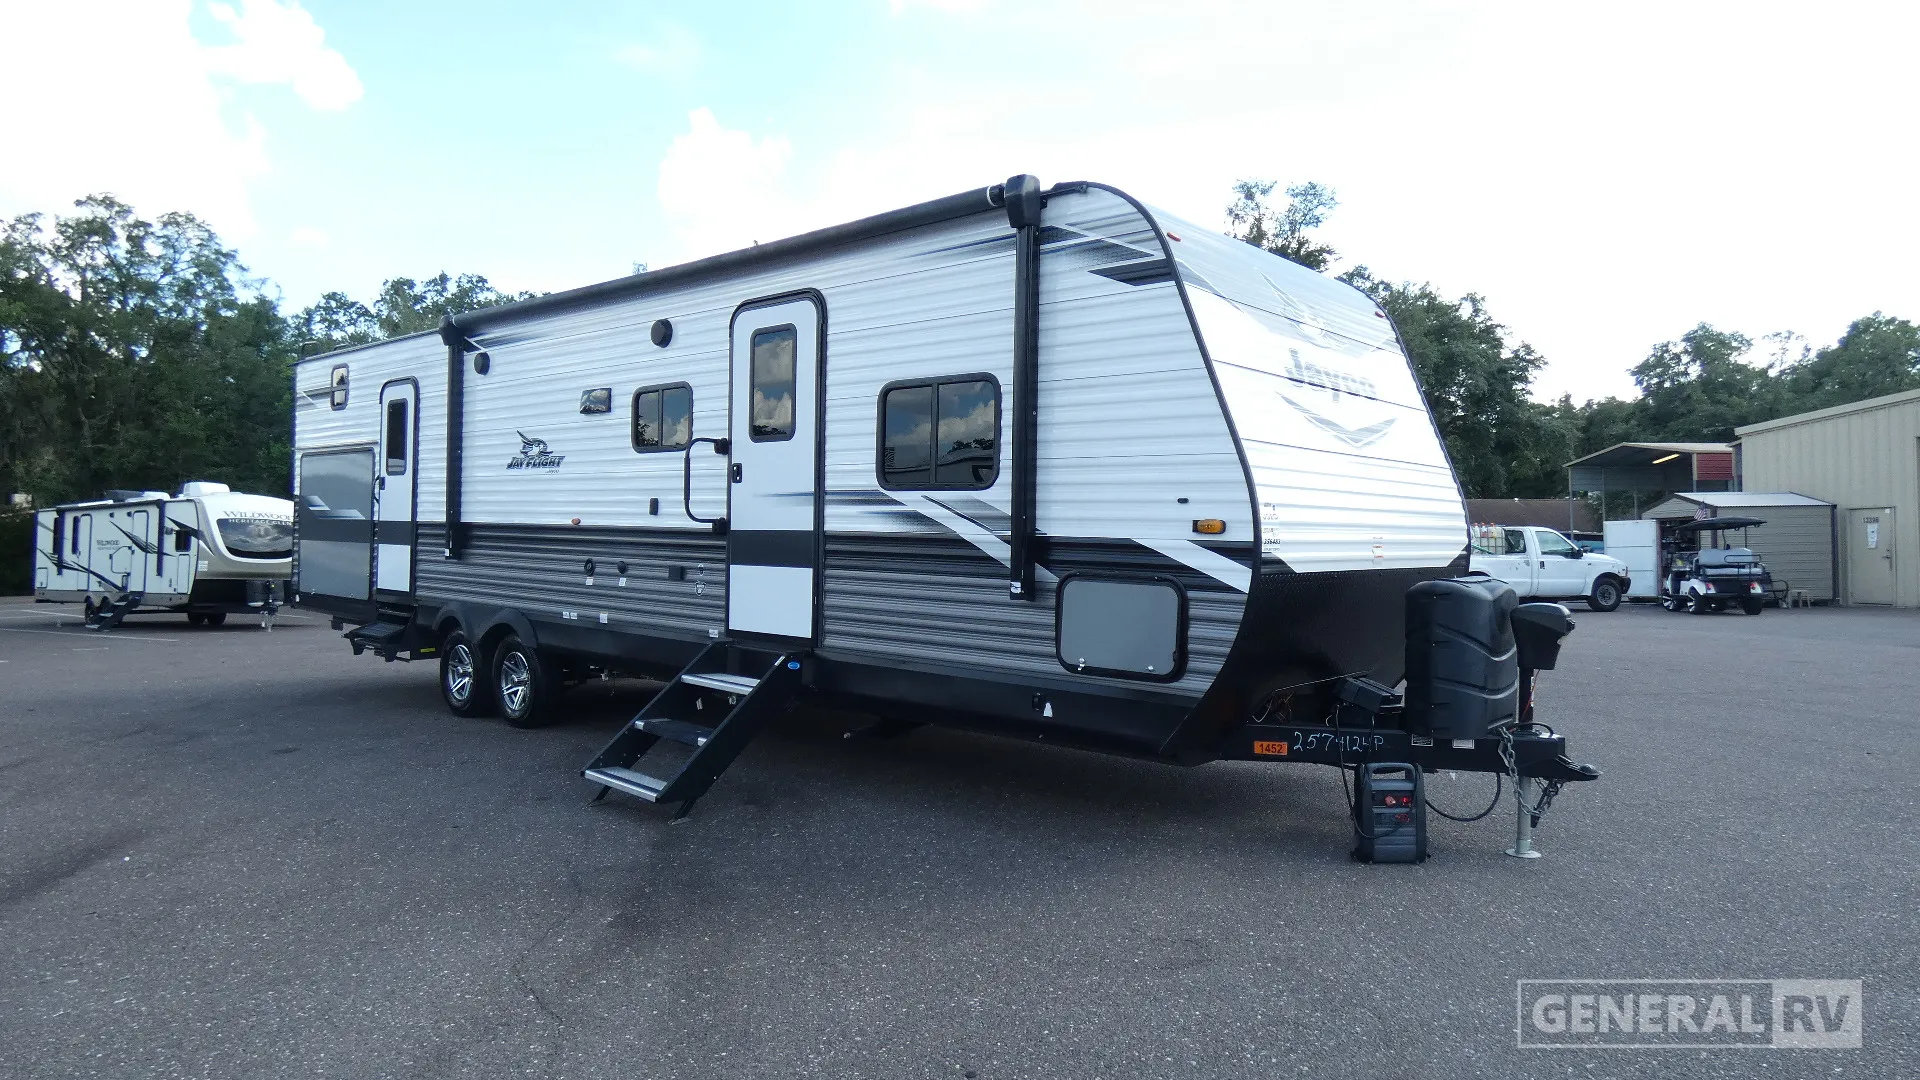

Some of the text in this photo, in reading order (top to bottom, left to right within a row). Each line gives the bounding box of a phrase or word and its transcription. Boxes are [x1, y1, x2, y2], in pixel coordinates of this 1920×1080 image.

[1284, 348, 1377, 403] Jayco
[506, 455, 565, 469] JAY FLIGHT
[1259, 743, 1284, 755] 1452
